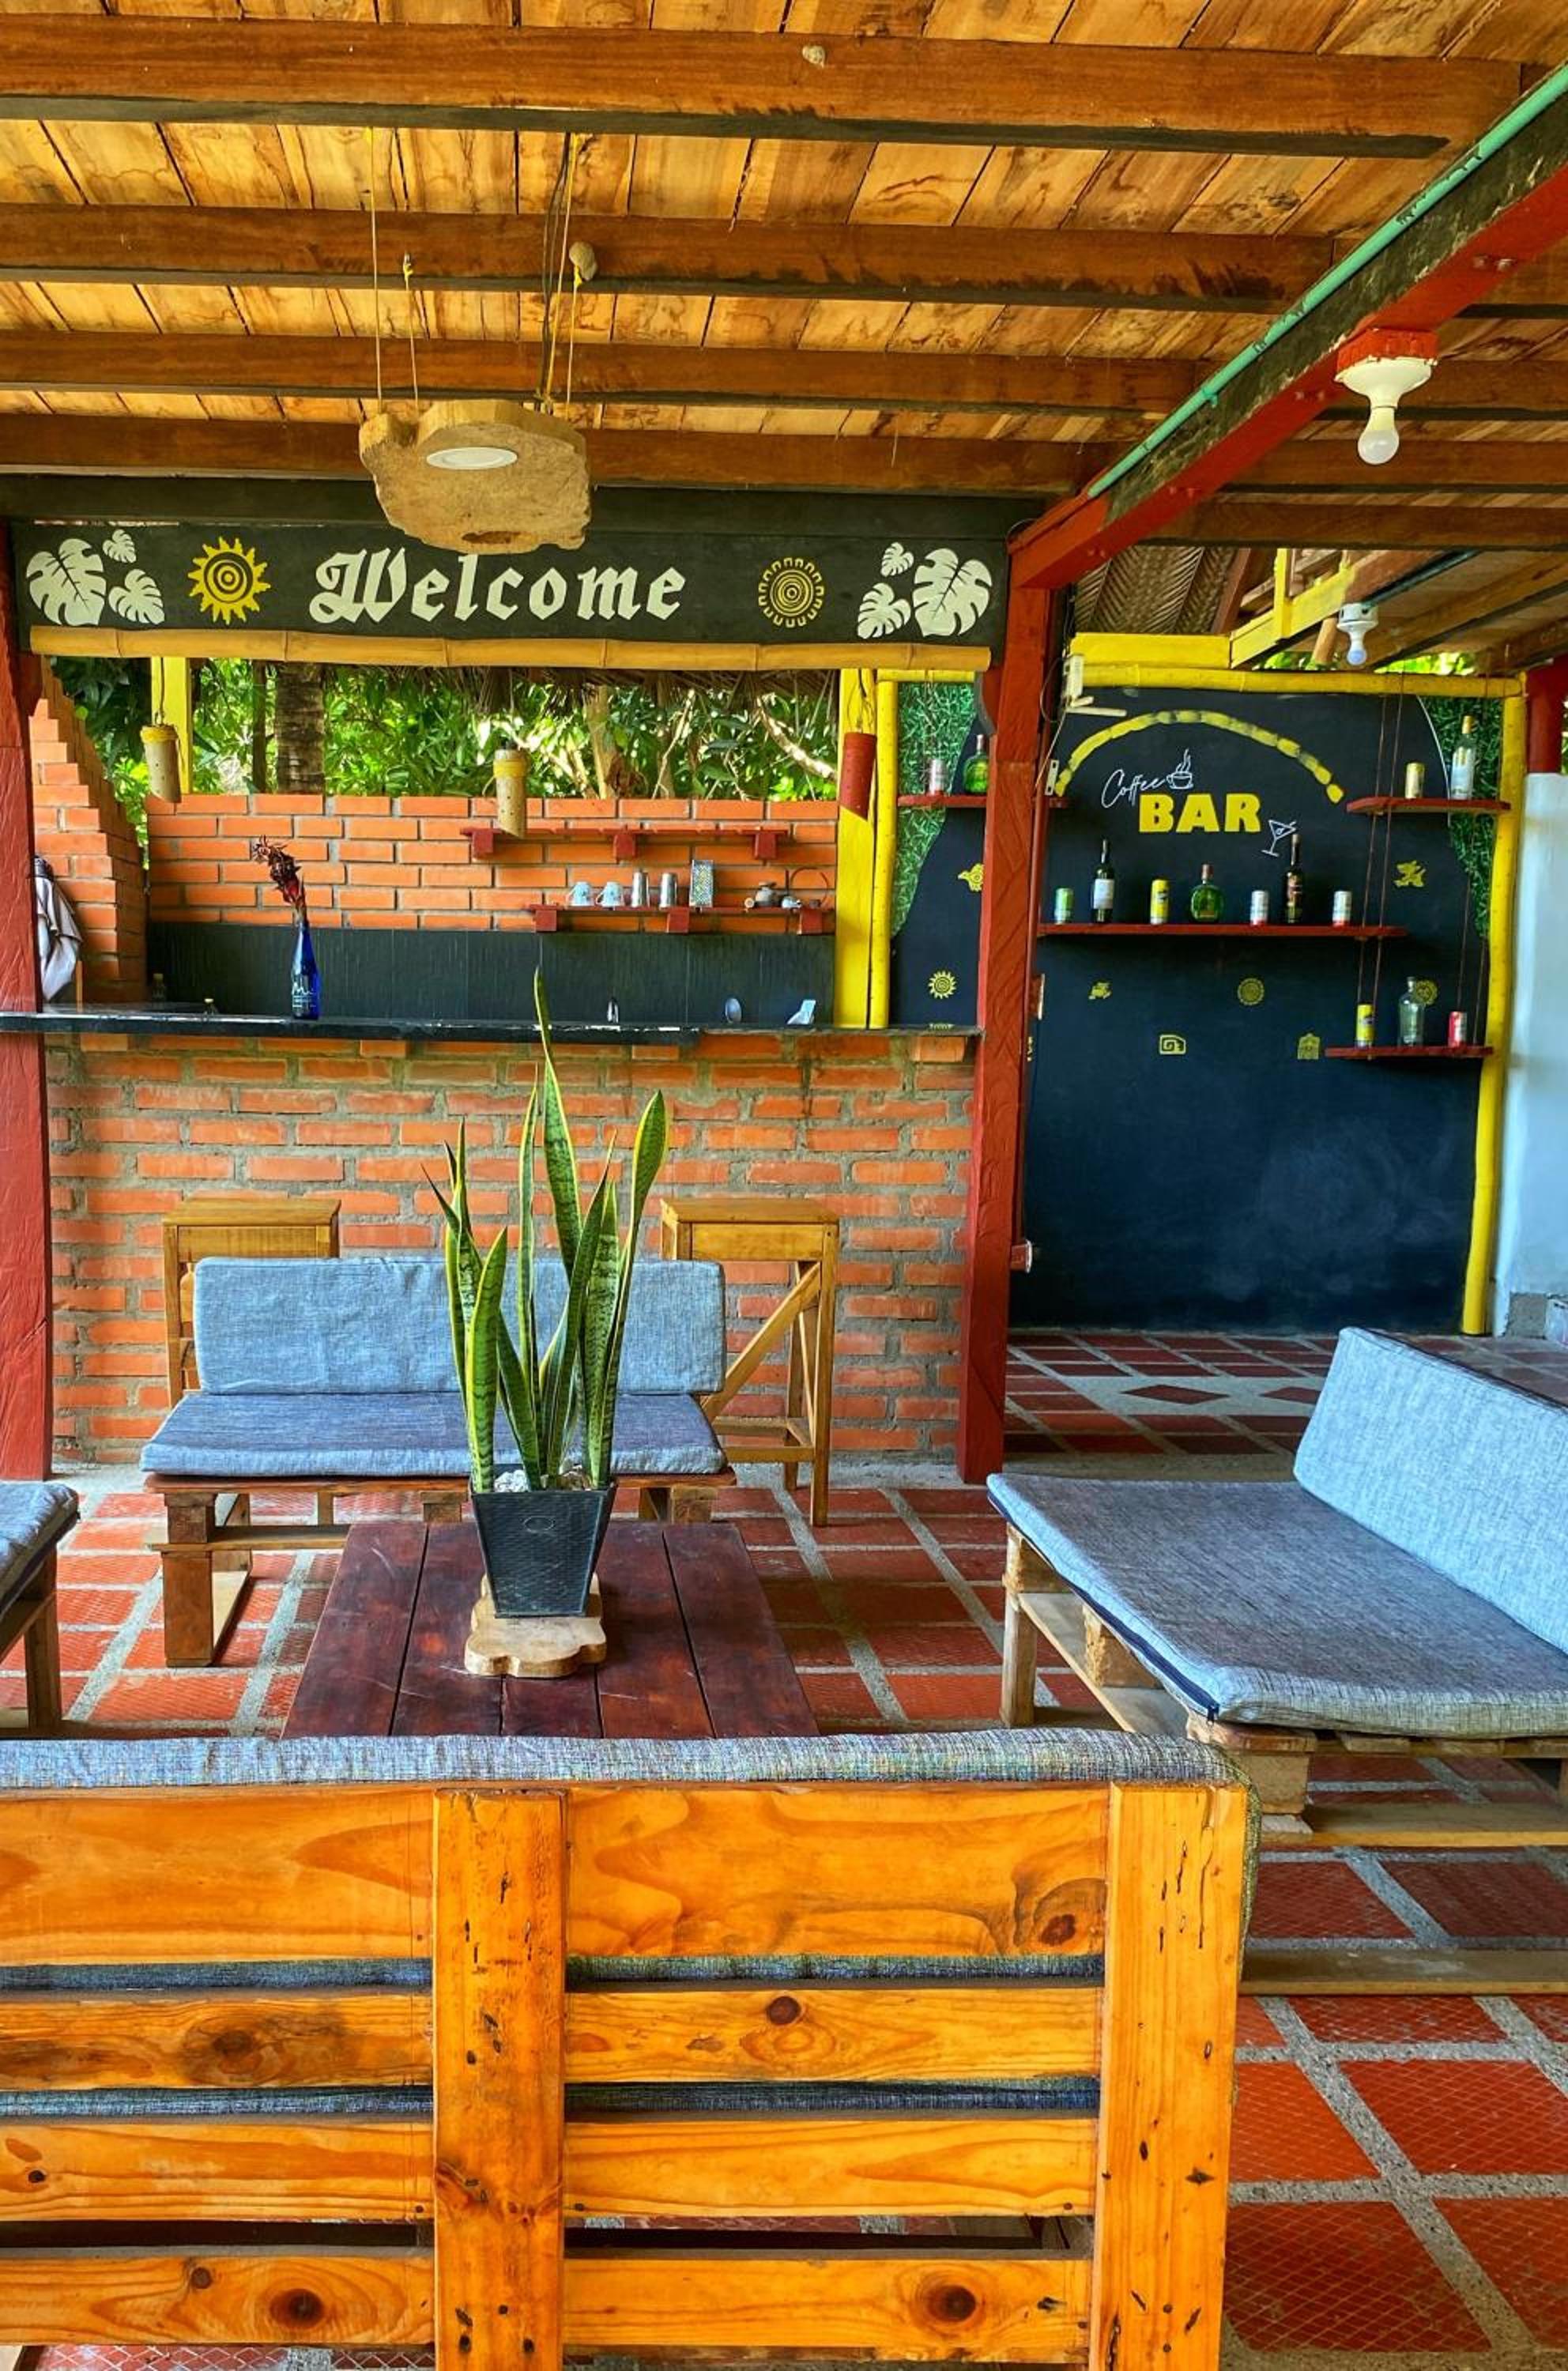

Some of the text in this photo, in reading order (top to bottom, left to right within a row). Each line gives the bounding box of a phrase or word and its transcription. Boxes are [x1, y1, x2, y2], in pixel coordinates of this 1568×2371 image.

[308, 547, 686, 624] Welcome
[1101, 769, 1167, 809] Coffee
[1139, 793, 1261, 833] BAR
